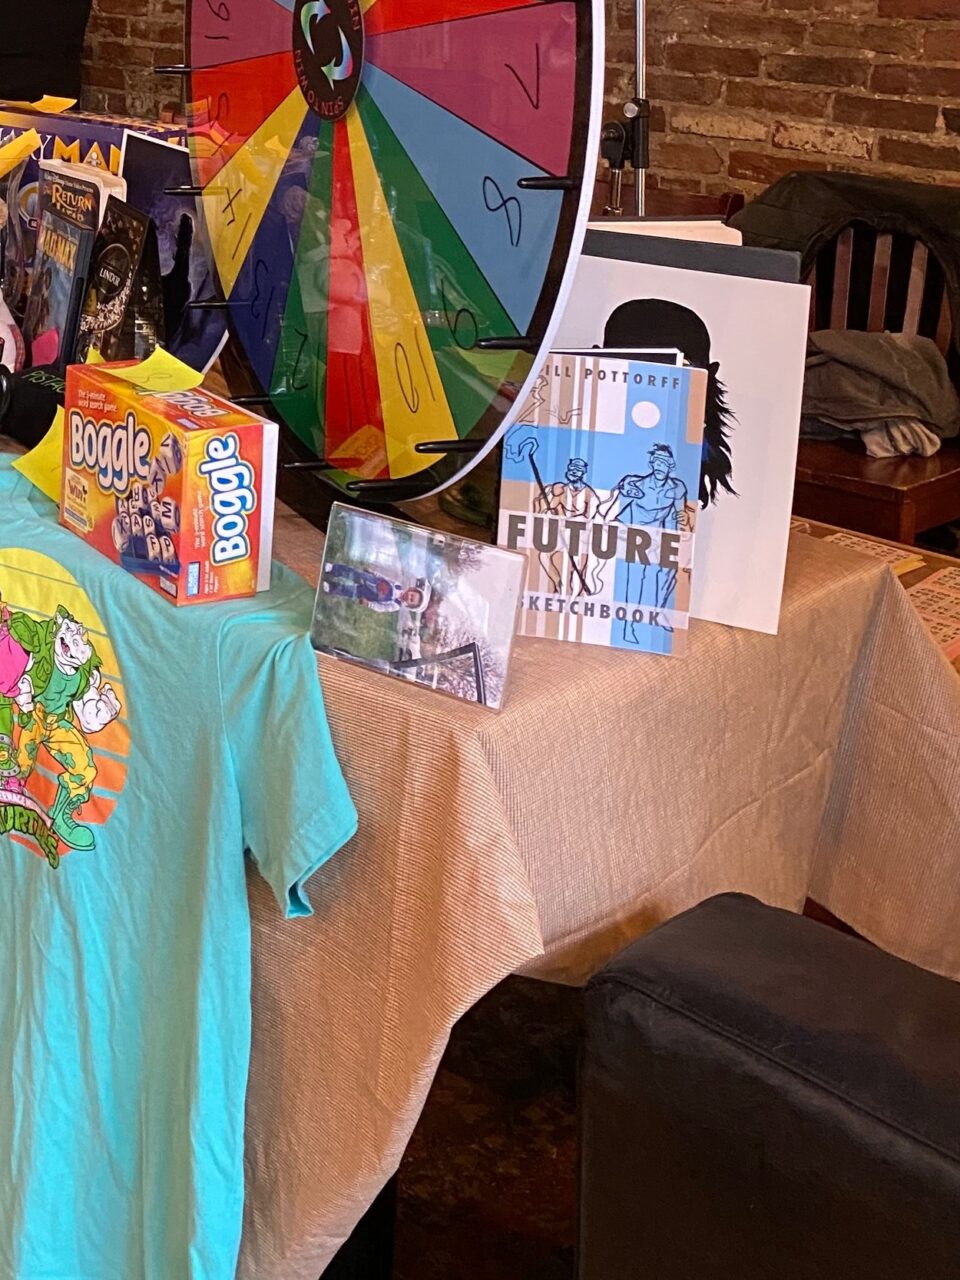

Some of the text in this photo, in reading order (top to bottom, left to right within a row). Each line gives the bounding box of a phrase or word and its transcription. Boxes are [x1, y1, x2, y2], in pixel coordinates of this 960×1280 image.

[320, 95, 345, 116] SPIN
[52, 182, 94, 213] RETURN
[482, 175, 523, 247] 8
[99, 268, 121, 287] LINDOR
[544, 363, 681, 390] ILL POTTORFF
[69, 410, 152, 497] Boggle
[199, 432, 256, 564] Boggle
[506, 513, 681, 571] FUTURE
